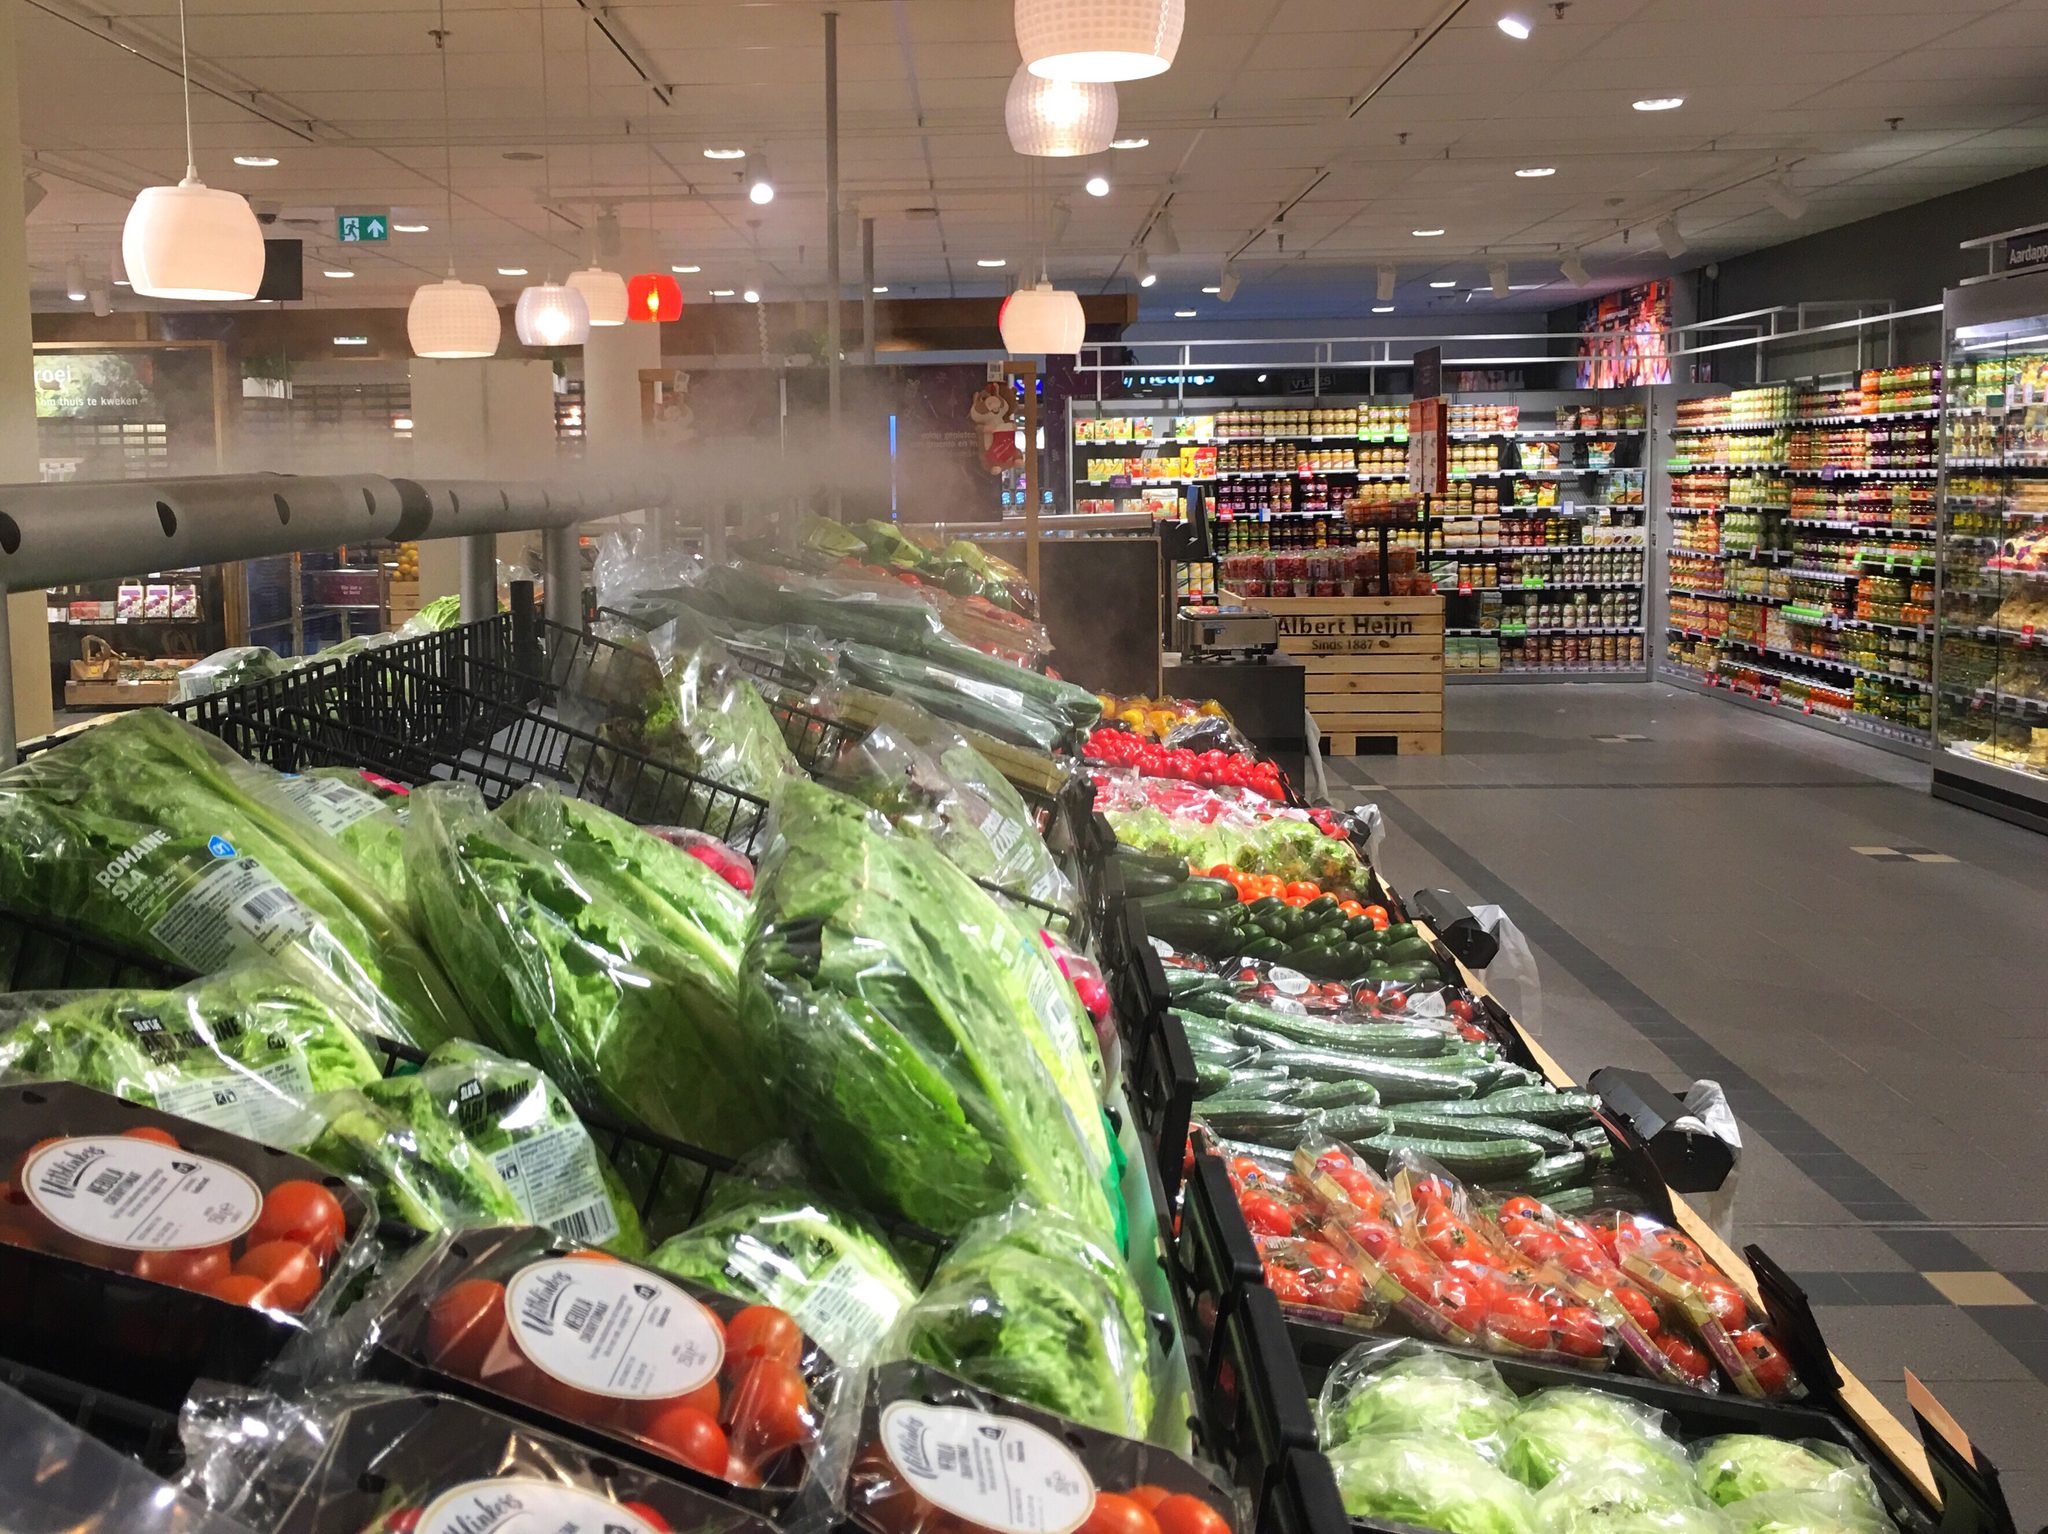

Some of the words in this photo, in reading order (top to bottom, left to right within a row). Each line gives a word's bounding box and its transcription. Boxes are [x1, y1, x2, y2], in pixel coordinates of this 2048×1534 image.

[2009, 244, 2048, 264] Aardapp
[59, 396, 84, 406] thuis
[87, 398, 97, 406] te
[100, 396, 138, 406] kweken
[1279, 617, 1346, 634] Albert
[1353, 615, 1413, 638] Heijn
[1311, 639, 1343, 650] Sinds
[1347, 639, 1373, 650] 1887
[96, 829, 171, 889] ROMAINE
[111, 869, 148, 902] SLA
[174, 1016, 242, 1049] ROMINE
[86, 1168, 126, 1196] NEBULA
[563, 1297, 594, 1333] NEBULA
